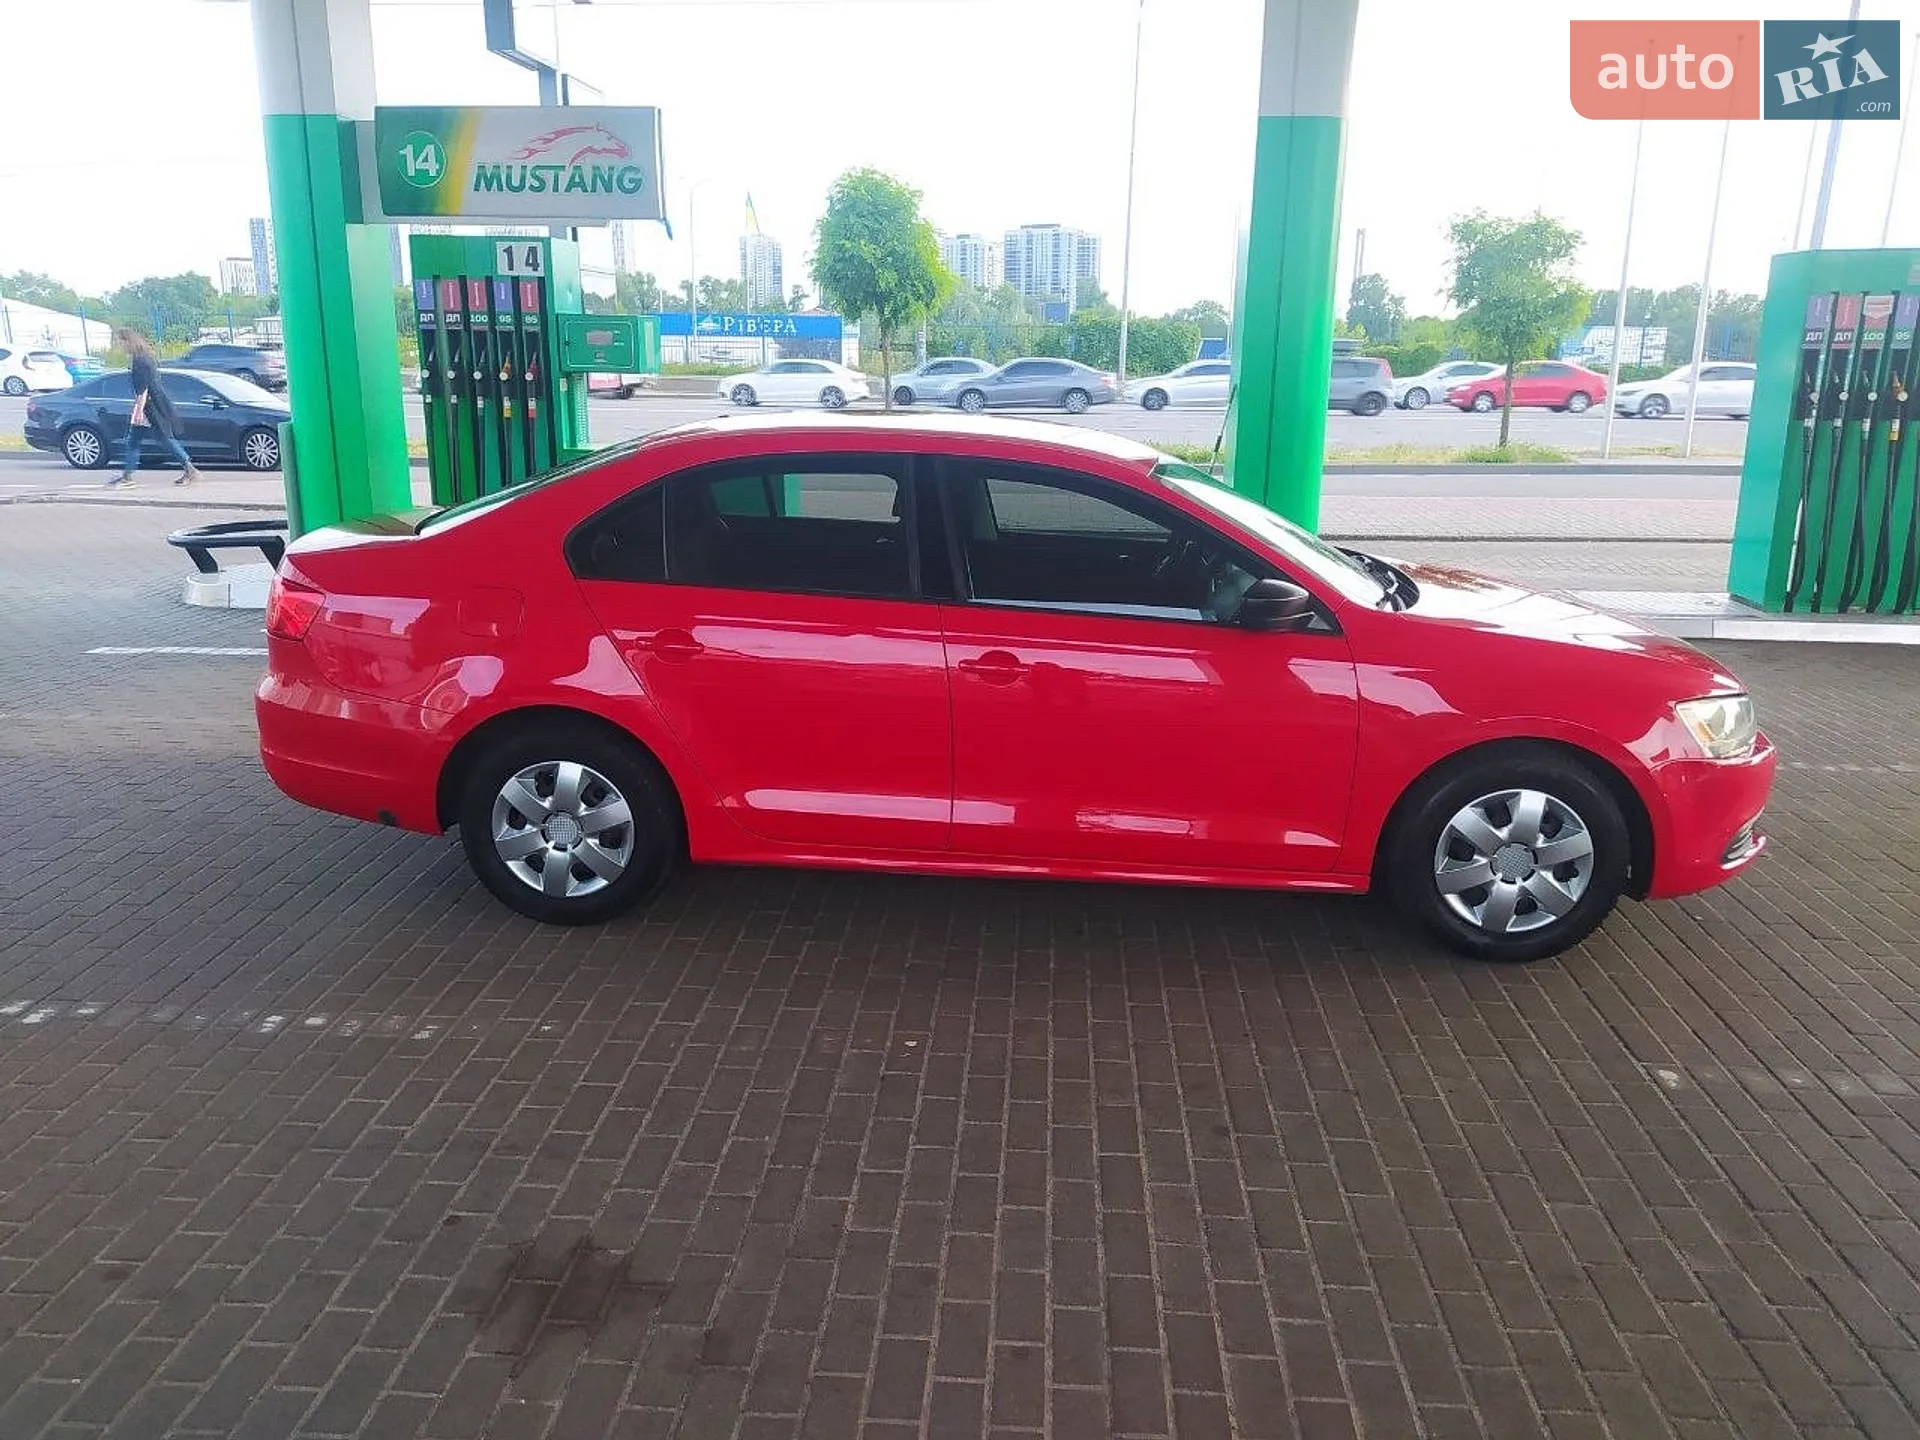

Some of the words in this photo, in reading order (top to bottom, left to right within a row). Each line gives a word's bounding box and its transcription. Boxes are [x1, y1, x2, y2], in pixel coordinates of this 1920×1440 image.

[400, 144, 438, 177] 14
[473, 165, 643, 193] MUSTANG
[470, 314, 489, 323] 100
[1863, 332, 1885, 341] 100
